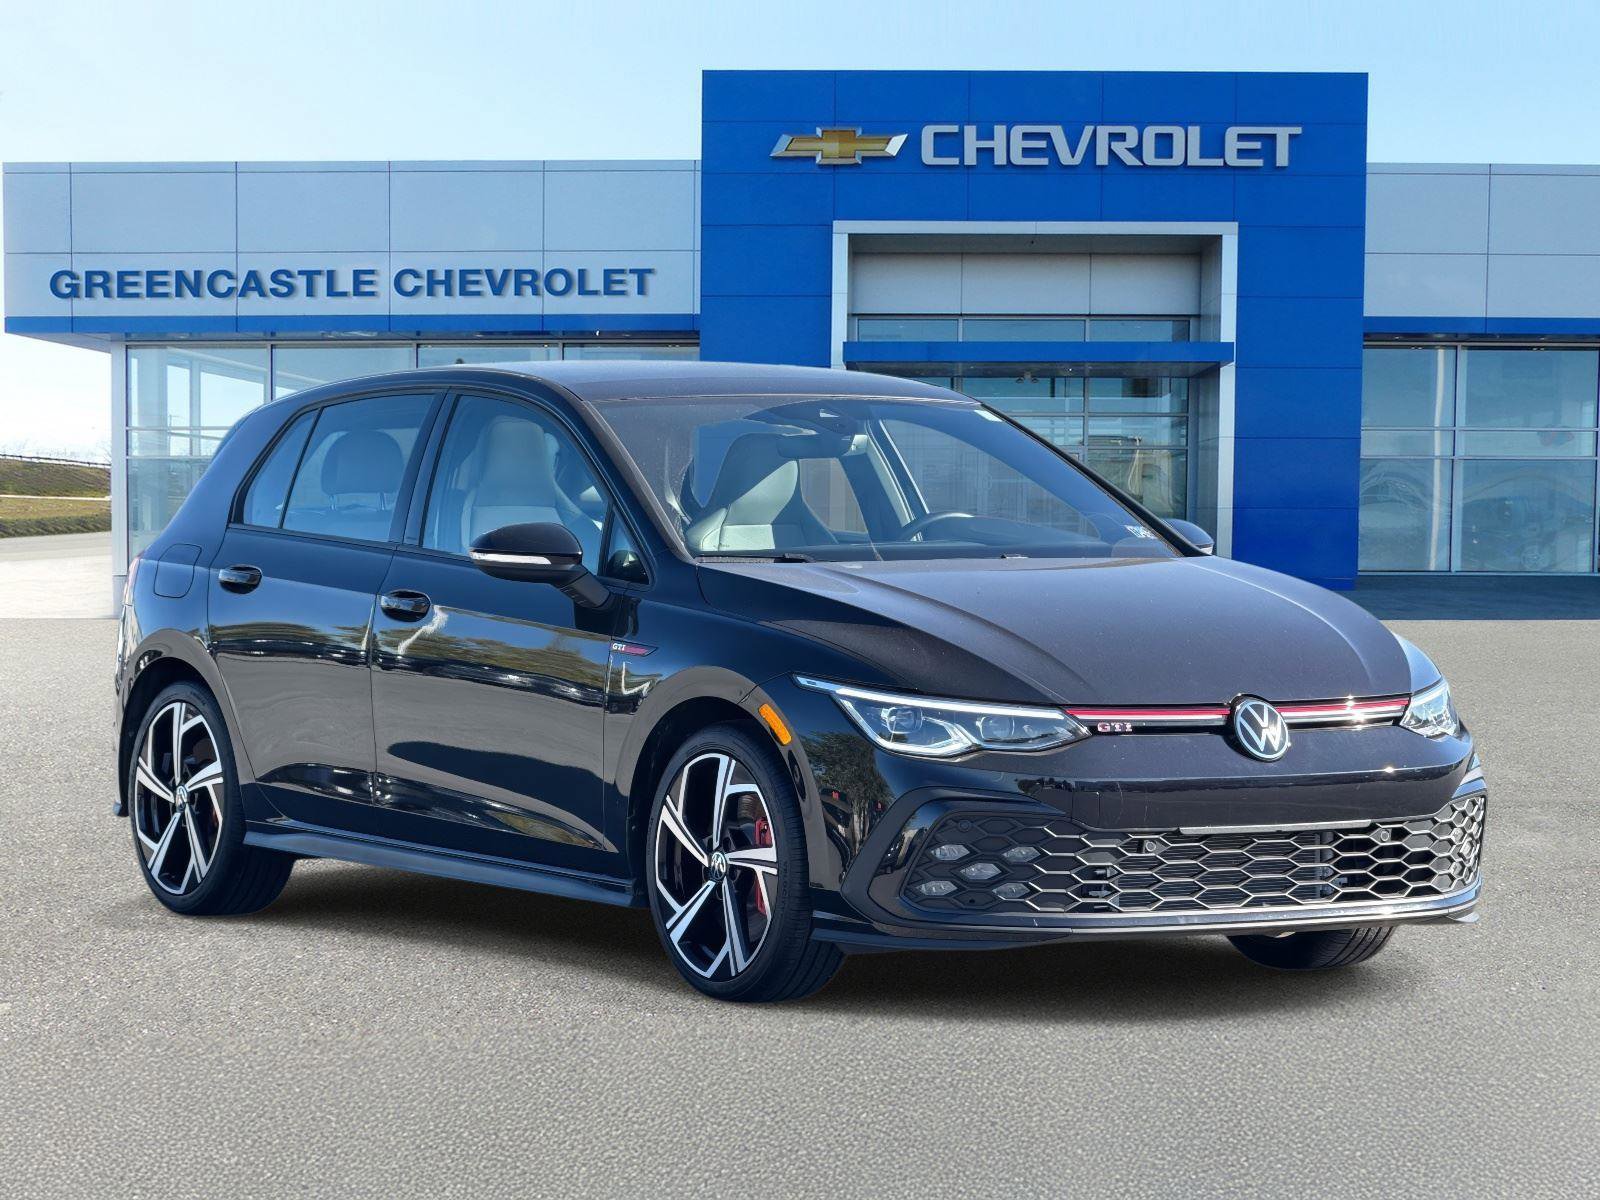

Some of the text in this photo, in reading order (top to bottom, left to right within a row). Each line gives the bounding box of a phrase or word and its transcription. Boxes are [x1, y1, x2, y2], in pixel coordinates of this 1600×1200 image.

[921, 124, 1303, 168] CHEVROLET
[50, 268, 656, 299] GREENCASTLE CHEVROLET
[612, 642, 626, 652] GTI
[1097, 722, 1133, 733] GTI
